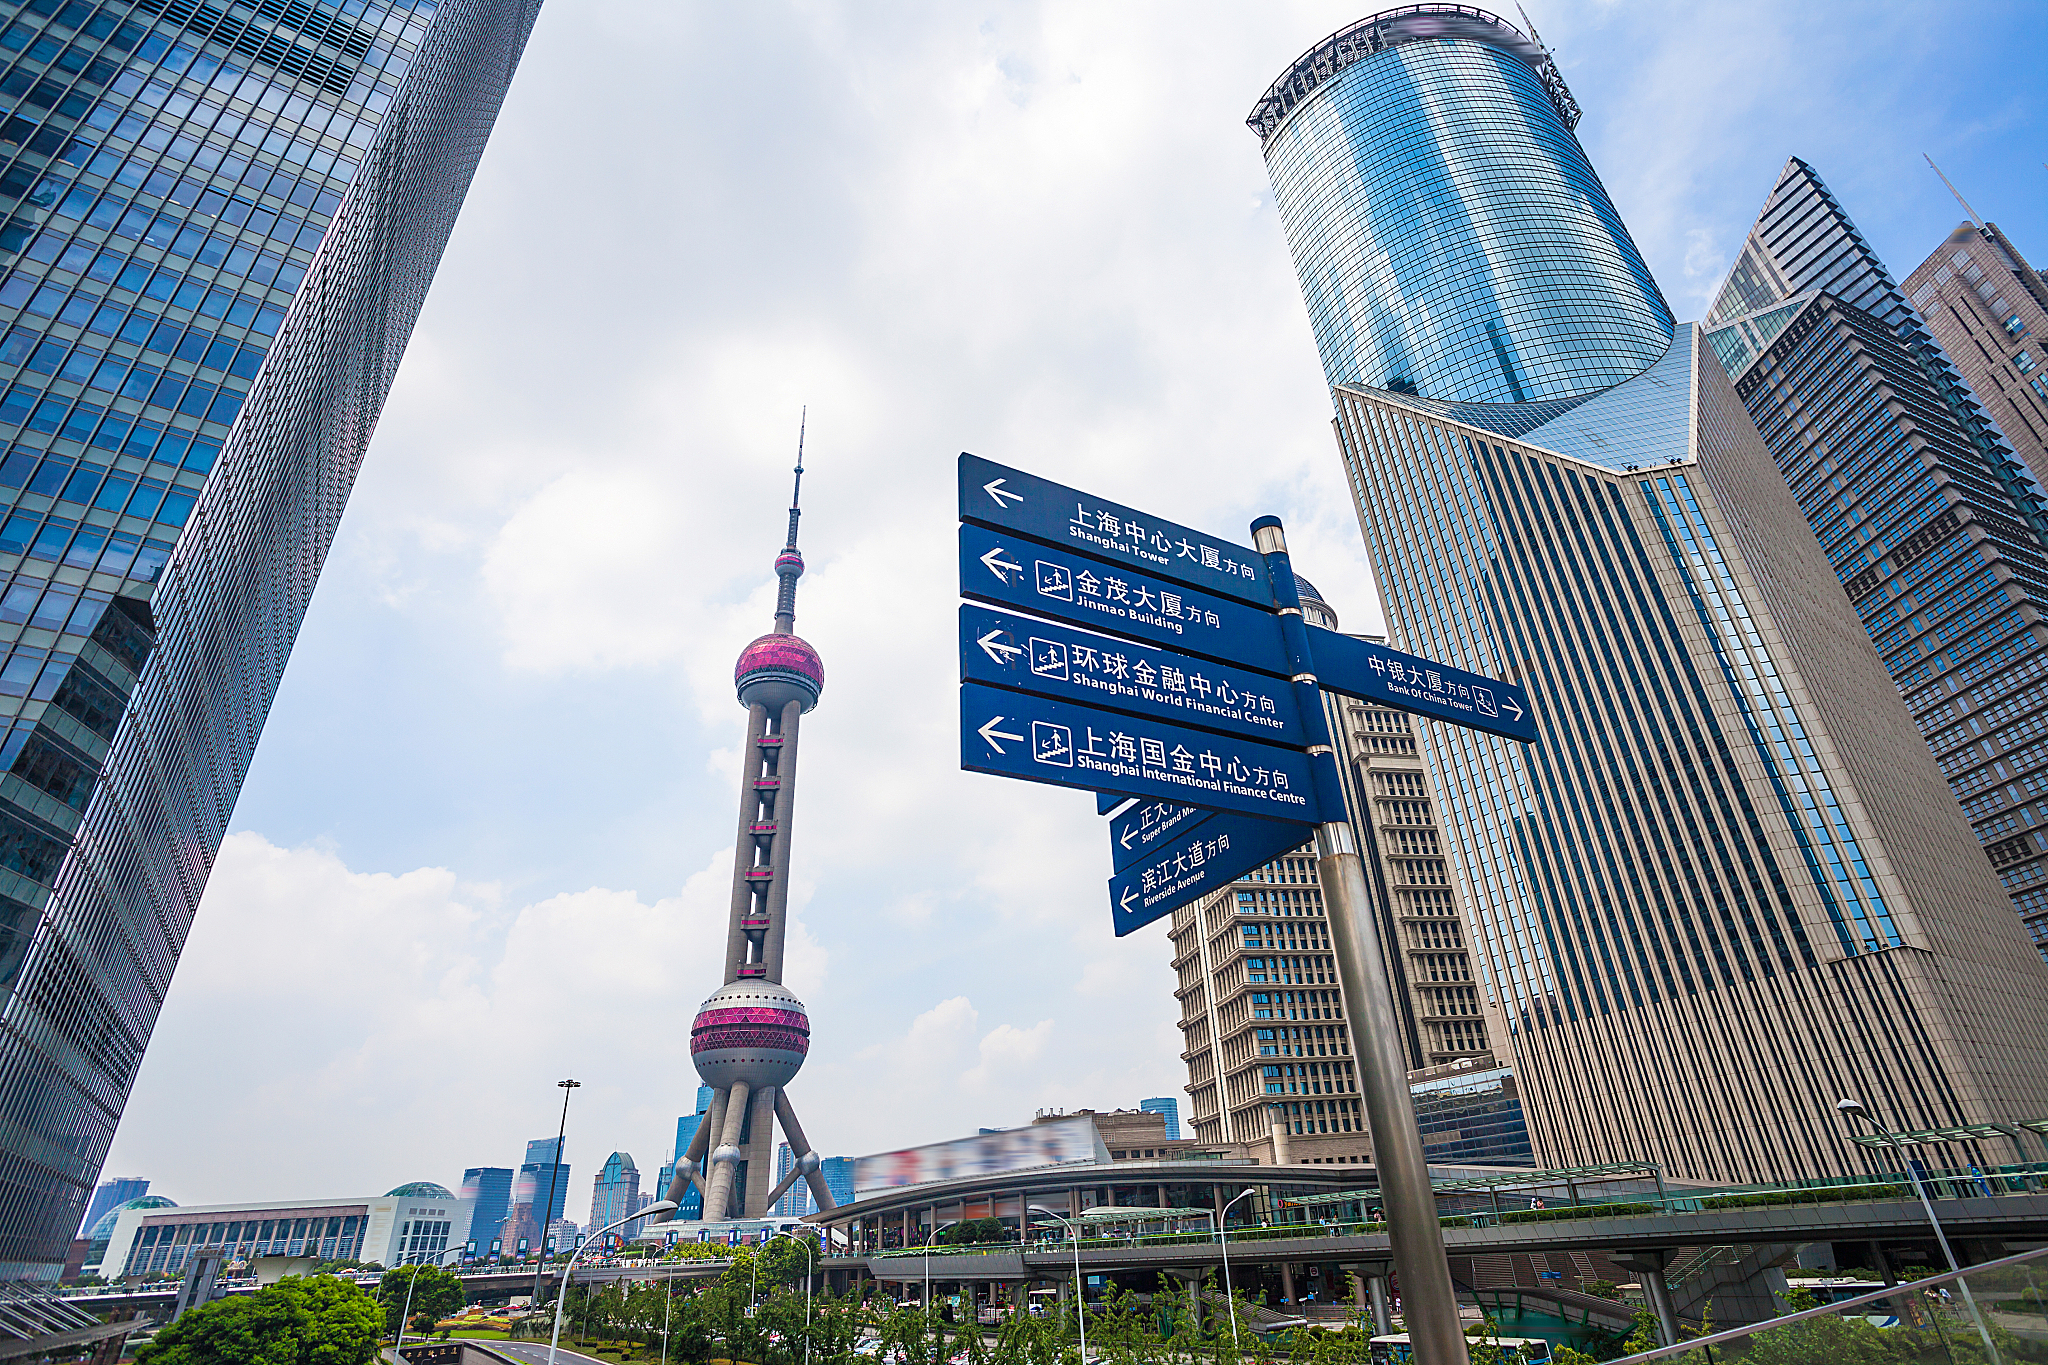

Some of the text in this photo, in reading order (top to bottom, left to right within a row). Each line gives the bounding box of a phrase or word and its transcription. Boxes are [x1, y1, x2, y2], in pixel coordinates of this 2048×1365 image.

[1069, 502, 1256, 581] 上海中心大厦方向
[1069, 525, 1170, 566] Shanghai Tower
[1075, 569, 1221, 629] 金茂大厦方向
[1076, 595, 1183, 635] Jinmao Building
[1071, 643, 1276, 714] 环球金融中心方向
[1073, 672, 1285, 729] Shanghai World Financial Center
[1367, 654, 1470, 700] 中银大厦方向
[1387, 681, 1473, 712] Bank Of China Tower
[1077, 726, 1289, 790] 上海国金中心方向
[1077, 754, 1306, 806] Shanghai International Finance Centre
[1141, 826, 1161, 844] Super
[1161, 810, 1182, 831] Brand
[1141, 834, 1230, 894] 滨江大道方向
[1143, 870, 1205, 908] Riverside Avenue
